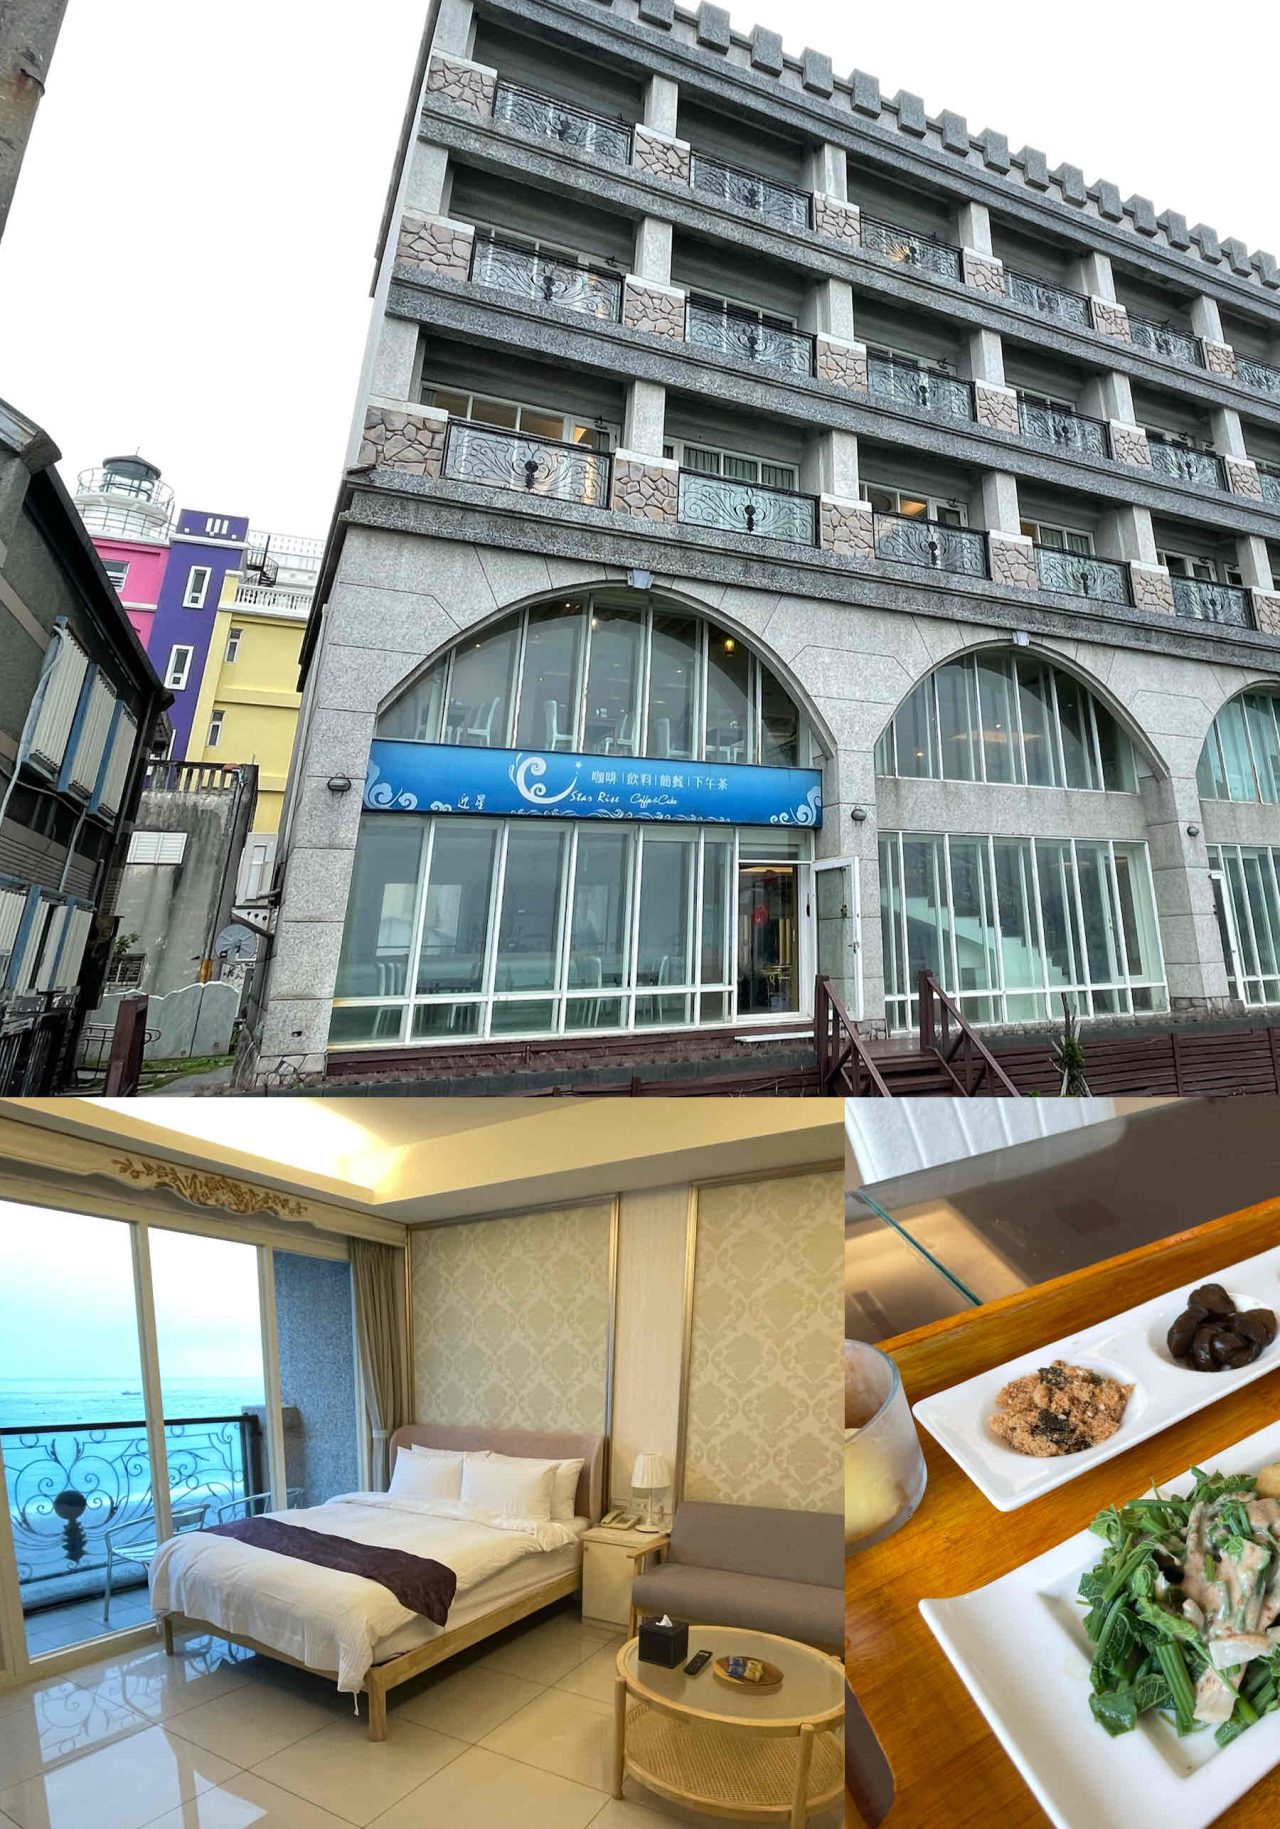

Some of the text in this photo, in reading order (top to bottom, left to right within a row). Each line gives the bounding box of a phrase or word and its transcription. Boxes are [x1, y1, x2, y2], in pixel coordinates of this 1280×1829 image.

[591, 771, 728, 792] 咖啡 飲料 簡餐 下午茶
[569, 790, 592, 803] Star
[598, 791, 620, 804] Rise
